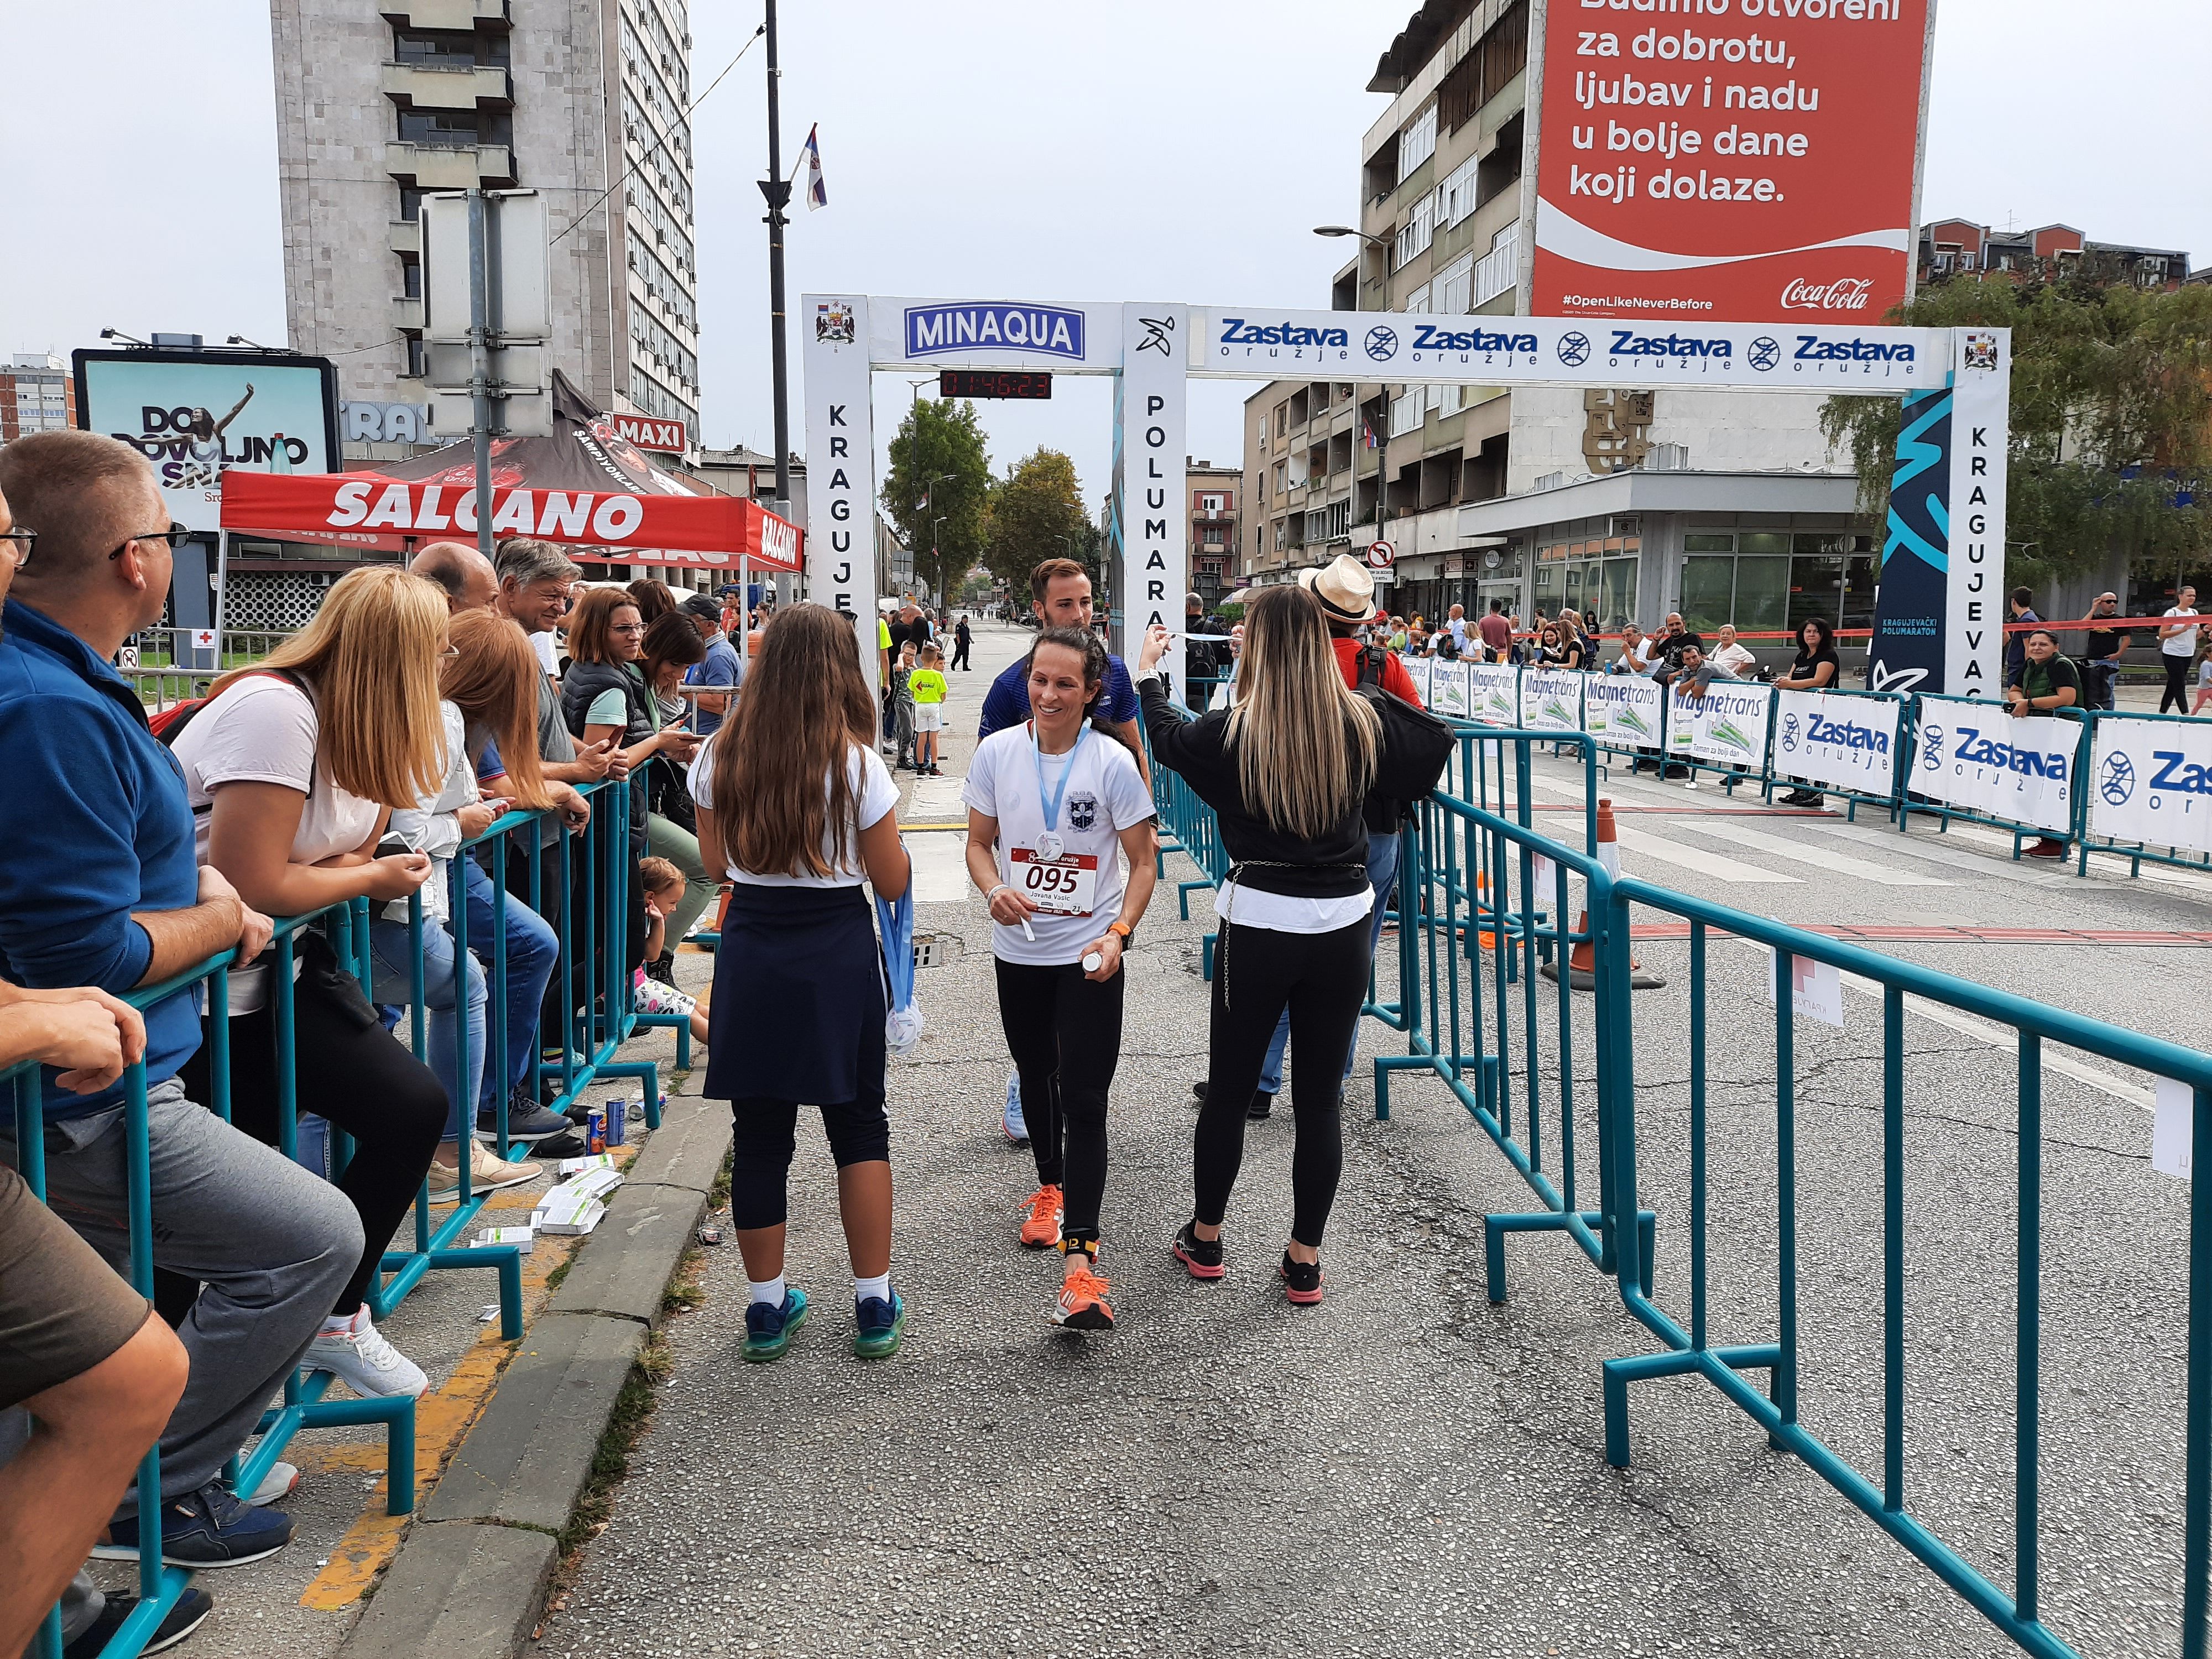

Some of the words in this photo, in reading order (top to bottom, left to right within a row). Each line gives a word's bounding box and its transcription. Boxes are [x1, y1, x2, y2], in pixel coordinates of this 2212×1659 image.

[1741, 0, 1900, 20] otvoreni
[1577, 31, 1620, 56] za
[1632, 28, 1796, 70] dobrotu,
[1574, 71, 1693, 109] ljubav
[1703, 76, 1713, 108] i
[1725, 80, 1819, 111] nadu
[1572, 126, 1594, 149] u
[1607, 119, 1702, 159] bolje
[1713, 124, 1809, 157] dane
[1569, 165, 1636, 204] koji
[1647, 168, 1785, 202] dolaze.
[1562, 294, 1713, 310] #OpenLikeNeverBefore
[1781, 278, 1876, 310] Coca-Cola
[916, 310, 1073, 351] MINAQUA
[1220, 319, 1348, 347] Zastava
[1412, 325, 1537, 353] Zastava
[1609, 330, 1732, 358] Zastava
[1220, 345, 1348, 362] oružje
[1412, 351, 1537, 367] oružje
[1794, 335, 1915, 362] Zastava
[1609, 357, 1731, 373] oružje
[1794, 361, 1914, 376] oružje
[944, 373, 1049, 397] 01:46:23
[142, 406, 193, 434] DO
[619, 420, 680, 447] MAXI
[111, 432, 309, 465] OVOLJNO
[326, 482, 643, 540] SALCANO
[1145, 395, 1166, 631] POLUMARA
[760, 514, 796, 565] SALCANO
[1882, 615, 1937, 627] KRAGUJEVAČKI
[1882, 627, 1937, 636] POLUMARATON
[1525, 674, 1578, 700] Magnetrans
[1807, 713, 1888, 754] Zastava
[1806, 744, 1888, 770] oružje
[1954, 727, 2067, 781] Zastava
[2150, 750, 2212, 796] Za
[1026, 865, 1079, 893] 095
[1030, 890, 1051, 899] Jovana
